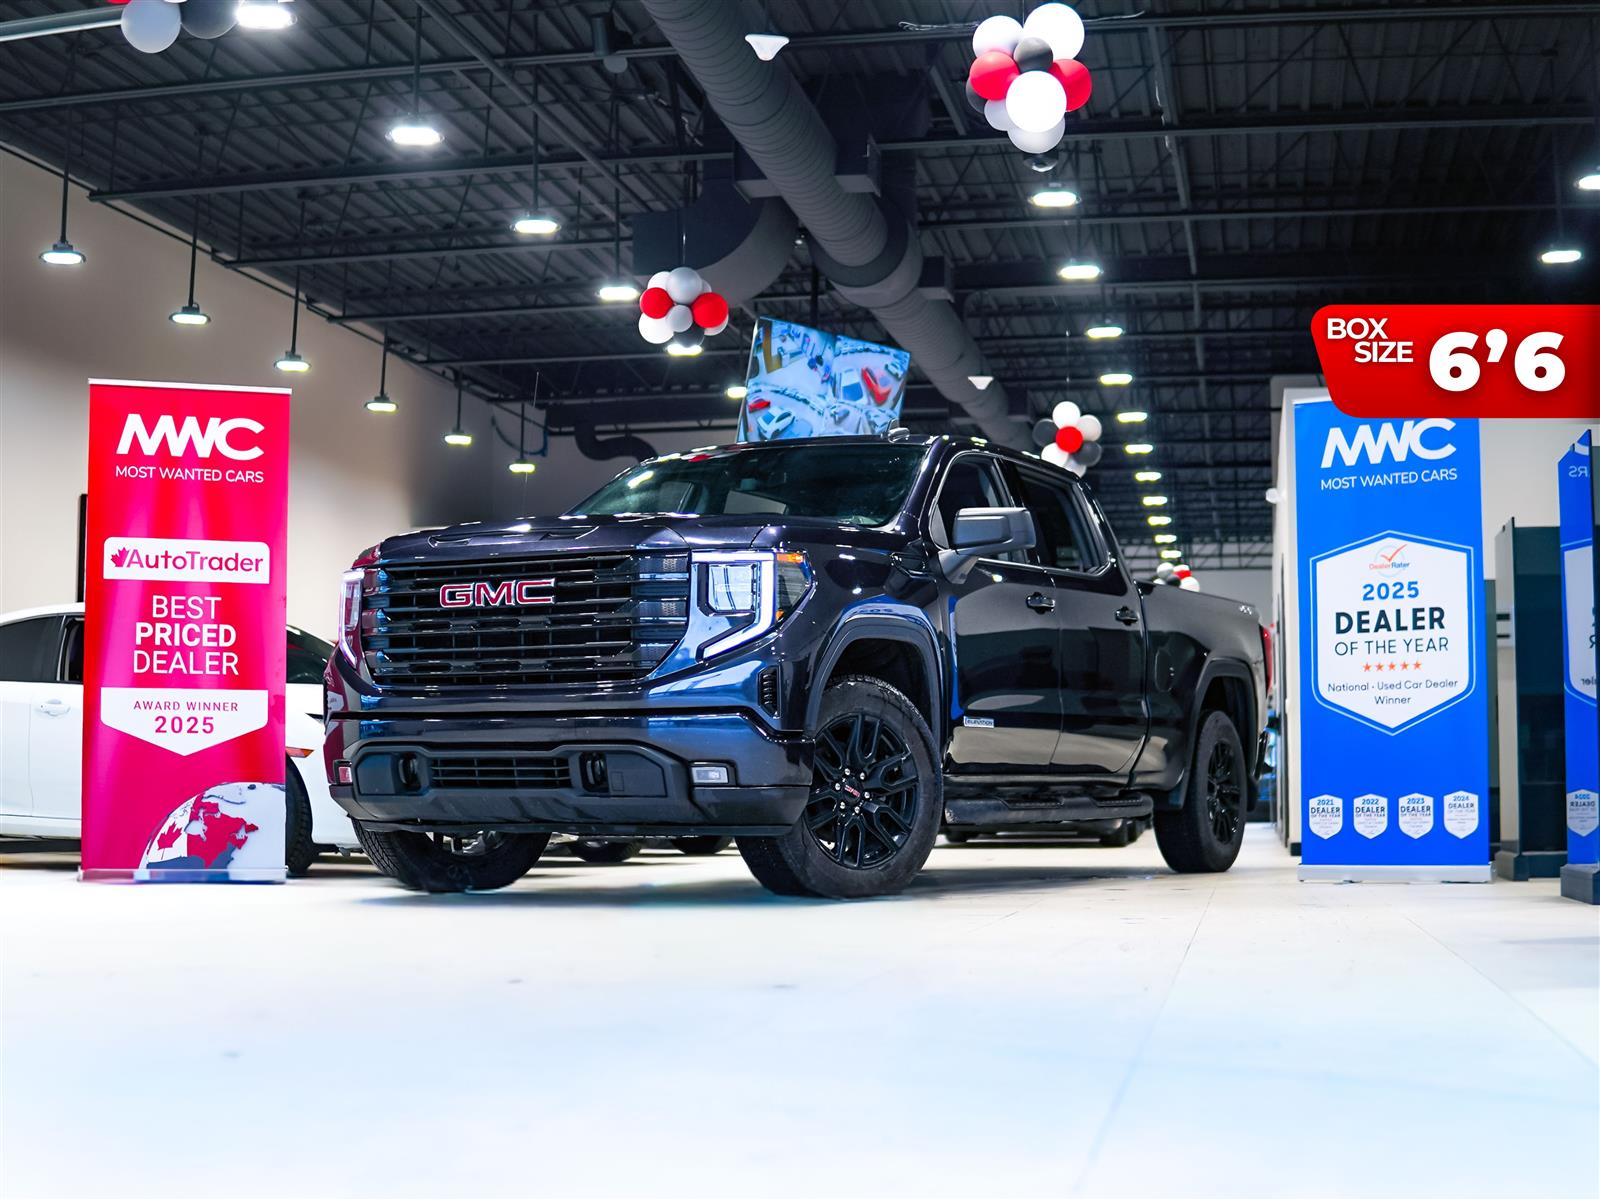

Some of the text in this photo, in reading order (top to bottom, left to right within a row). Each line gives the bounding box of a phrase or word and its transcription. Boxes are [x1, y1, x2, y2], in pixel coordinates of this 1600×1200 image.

[116, 413, 265, 461] MWC
[1320, 418, 1457, 469] MWC
[115, 466, 264, 483] MOST WANTED CARS
[1320, 468, 1458, 490] MOST WANTED CARS
[126, 549, 264, 572] AutoTrader
[440, 578, 556, 608] GMC
[1362, 581, 1420, 601] 2025
[152, 594, 222, 620] BEST
[1335, 606, 1445, 634] DEALER
[136, 622, 236, 647] PRICED
[1334, 637, 1449, 656] OF THE YEAR
[133, 650, 239, 676] DEALER
[1328, 682, 1369, 692] National
[1377, 681, 1402, 690] Used
[1404, 680, 1422, 690] Car
[1425, 679, 1458, 688] Dealer
[134, 700, 238, 712] AWARD WINNER
[1374, 696, 1411, 705] Winner
[154, 716, 214, 734] 2025
